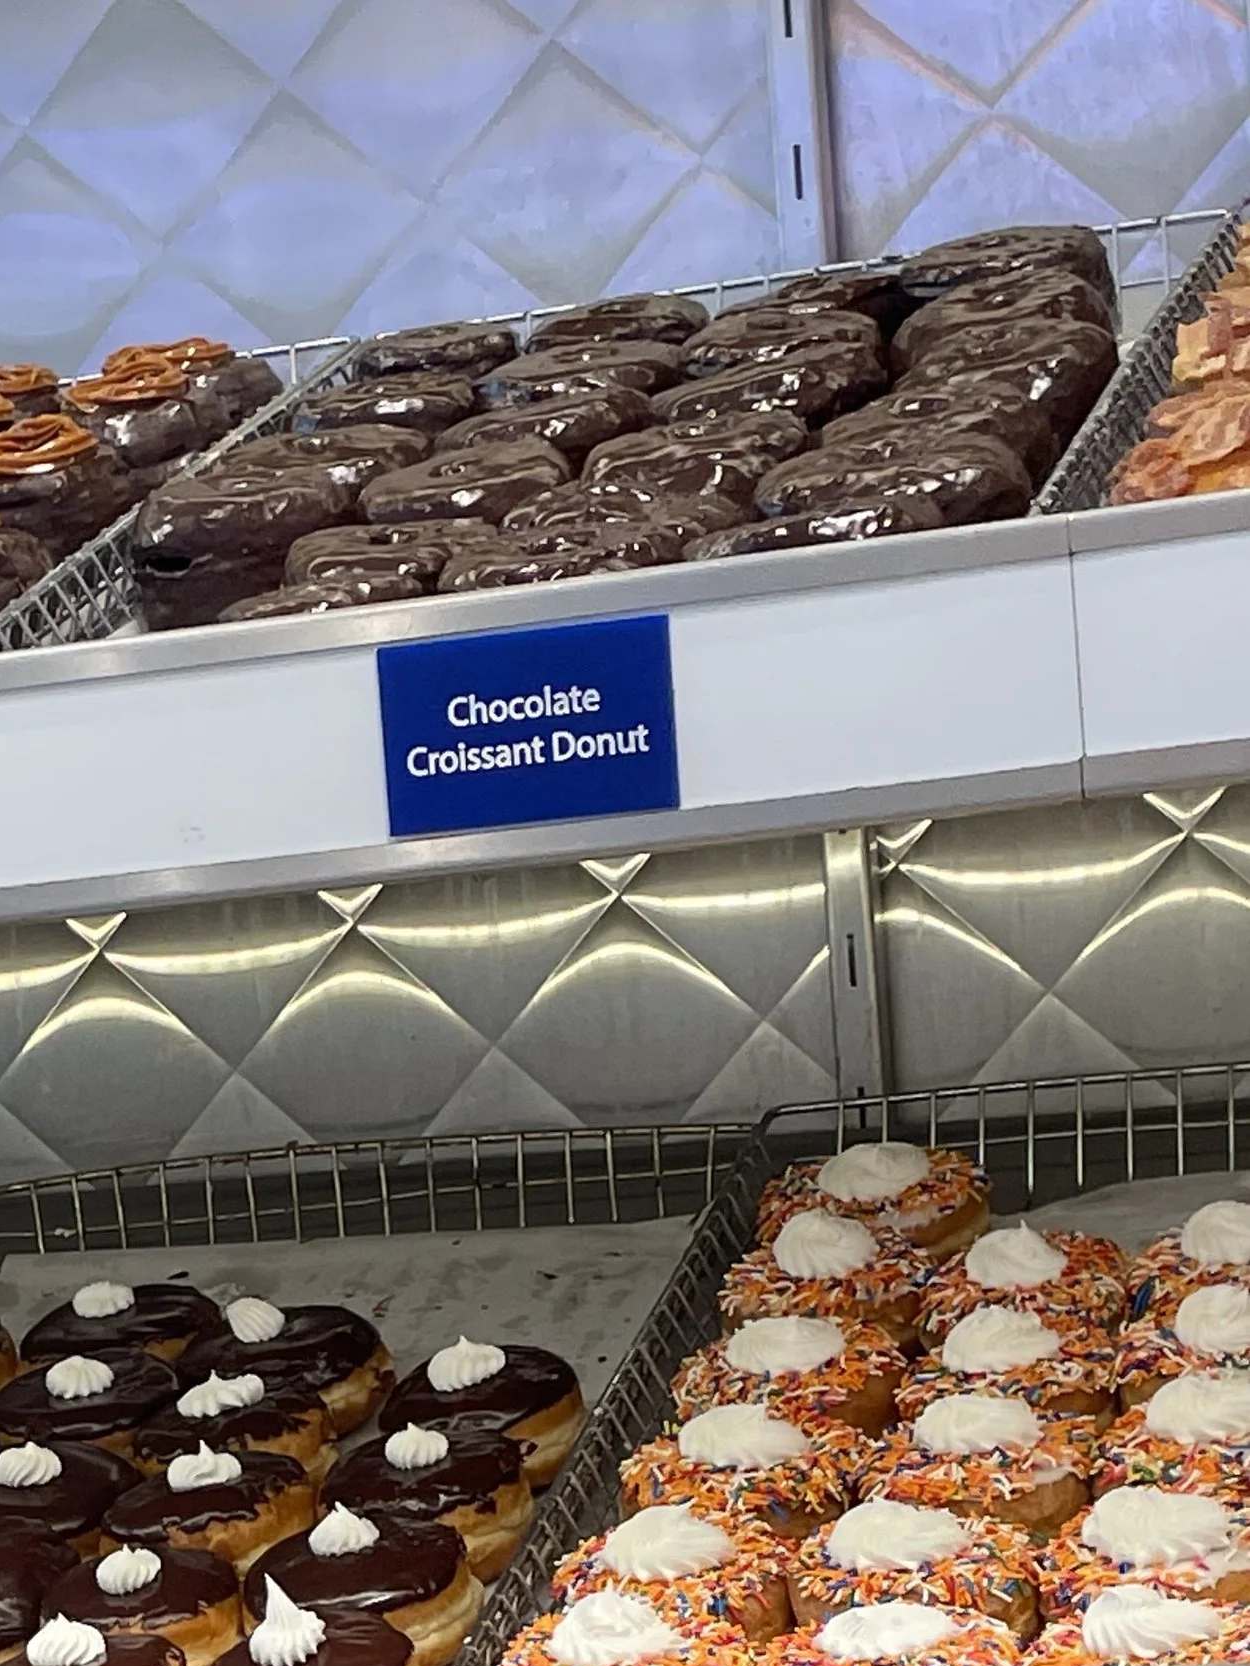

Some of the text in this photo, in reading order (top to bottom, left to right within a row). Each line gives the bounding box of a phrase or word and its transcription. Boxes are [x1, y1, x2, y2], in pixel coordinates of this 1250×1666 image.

[447, 684, 602, 727] Chocolate
[406, 725, 651, 777] Croissant Donut
